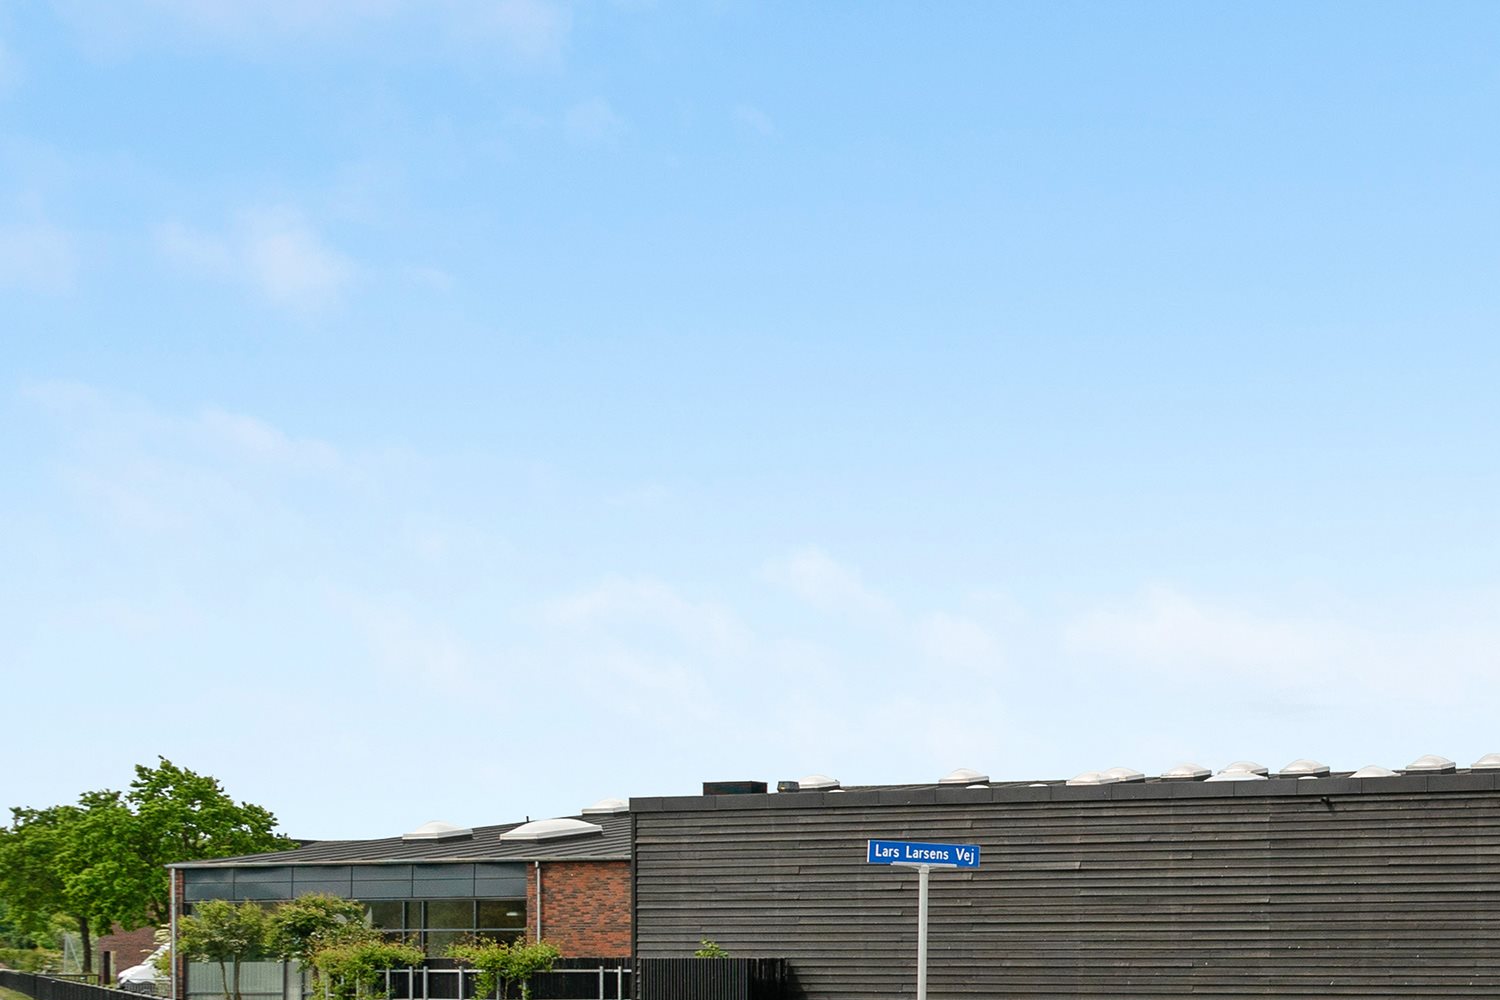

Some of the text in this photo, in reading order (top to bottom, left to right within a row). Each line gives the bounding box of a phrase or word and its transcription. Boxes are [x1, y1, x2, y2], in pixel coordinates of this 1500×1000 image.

[875, 844, 975, 865] Lars Larsens Vej
